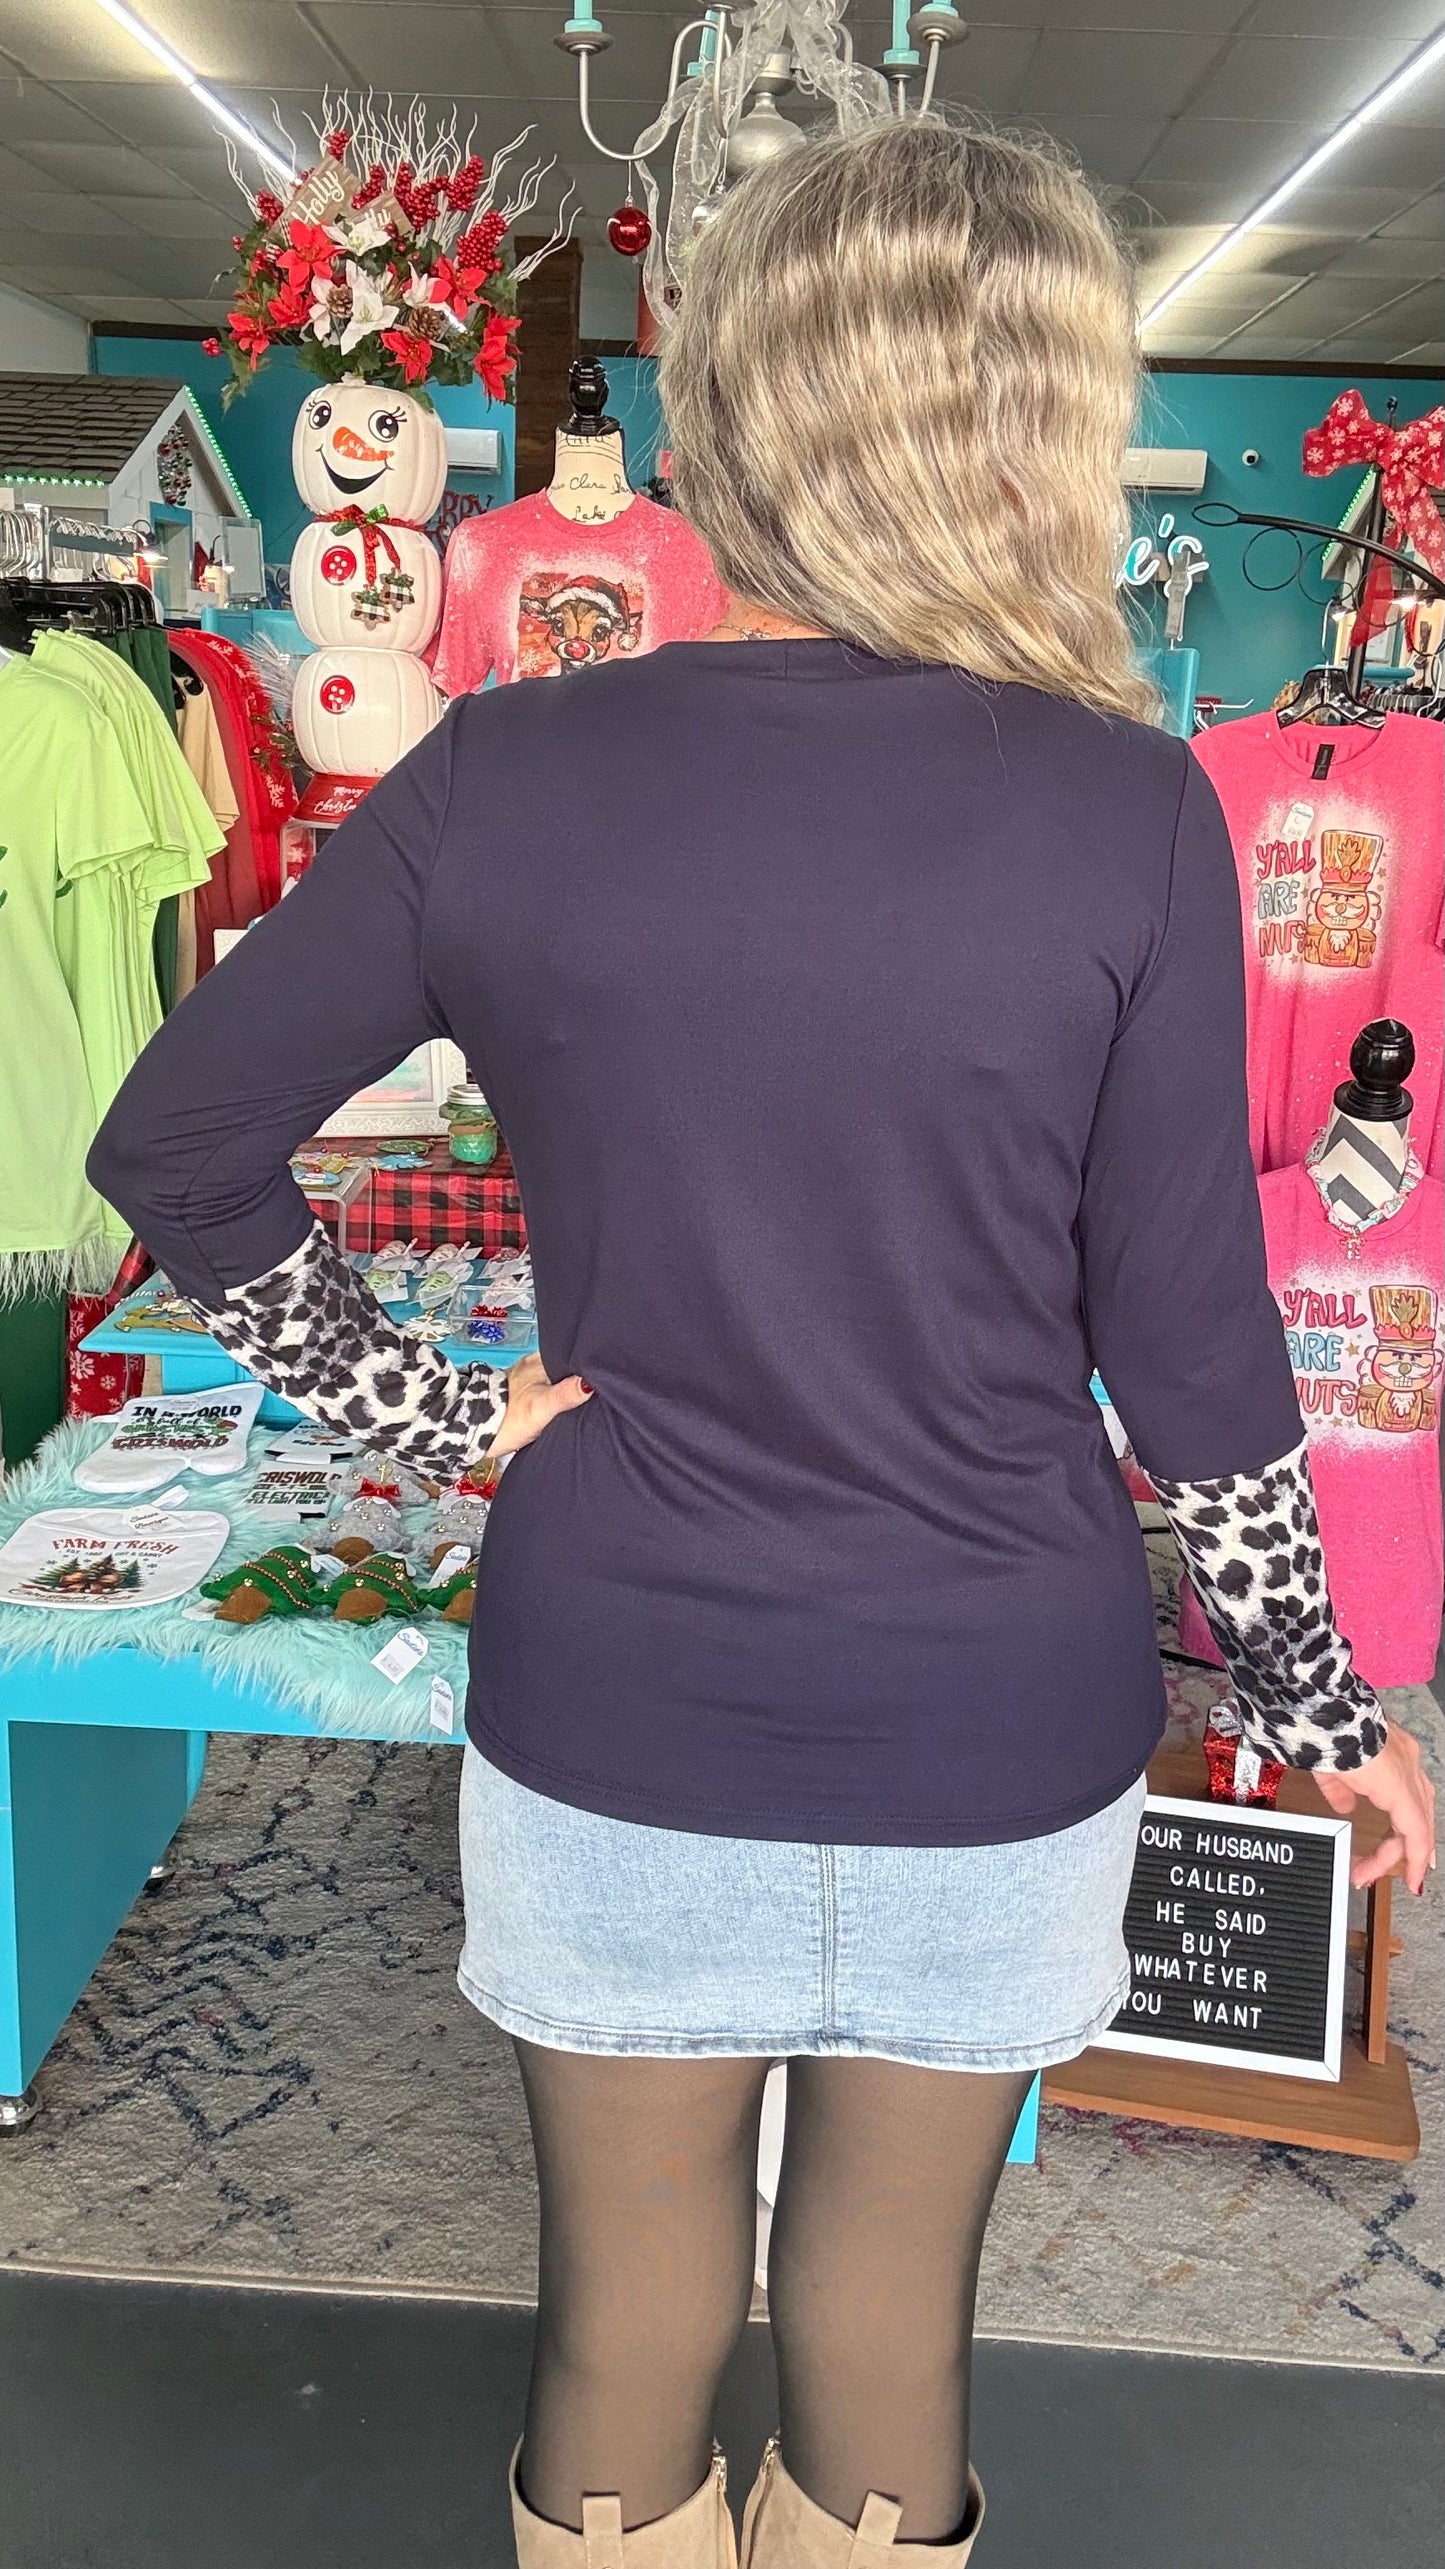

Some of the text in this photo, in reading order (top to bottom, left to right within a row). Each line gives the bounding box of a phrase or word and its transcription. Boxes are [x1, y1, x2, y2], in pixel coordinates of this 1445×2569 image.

[291, 170, 345, 225] Holly
[1255, 839, 1317, 881] Y'ALL
[1258, 880, 1301, 920] ARE
[1283, 1287, 1367, 1330] Y'ALL
[1285, 1331, 1344, 1373] ARE
[132, 1406, 157, 1418] IN
[52, 1538, 107, 1550] FARM
[112, 1540, 179, 1555] FRESH
[1195, 1832, 1294, 1865] HUSBAND
[1170, 1865, 1265, 1897] CALLED,
[1155, 1900, 1267, 1936] HE SAID
[1181, 1932, 1232, 1959] BUY
[1134, 1953, 1268, 1994] WHATEVER
[1192, 1998, 1263, 2030] WANT
